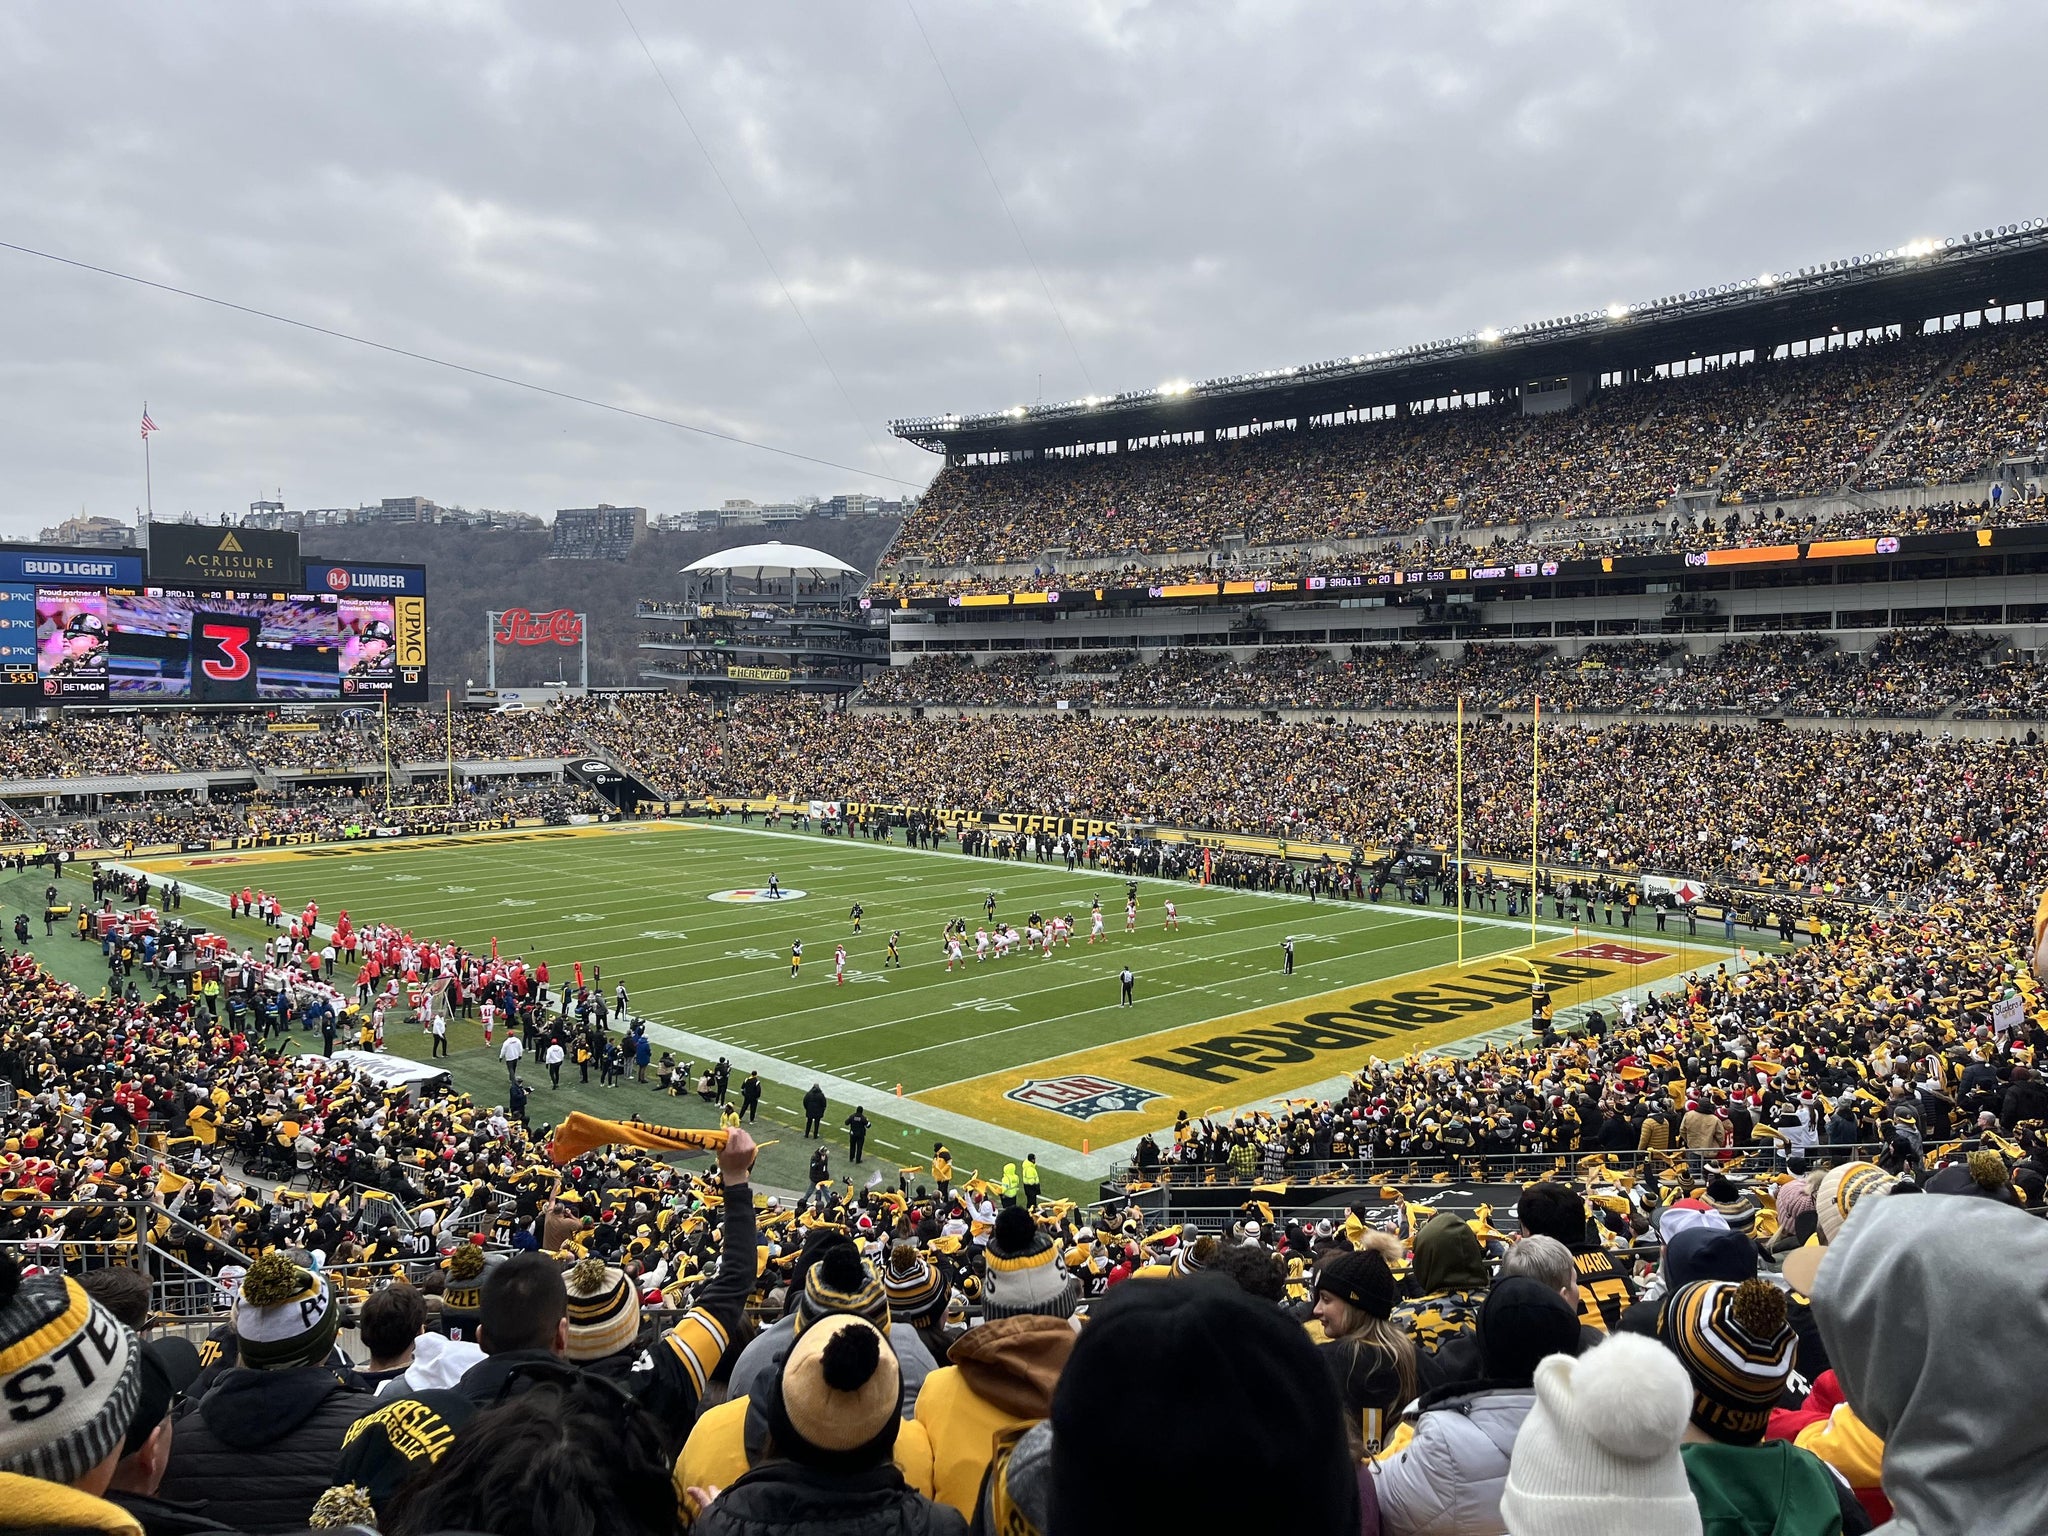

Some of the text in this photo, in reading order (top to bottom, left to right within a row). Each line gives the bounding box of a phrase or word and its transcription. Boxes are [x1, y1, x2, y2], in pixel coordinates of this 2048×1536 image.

[185, 554, 274, 569] ACRISURE
[25, 561, 114, 576] BUD LIGHT
[204, 568, 257, 578] STADIUM
[1472, 568, 1506, 578] CHIEFS
[330, 572, 405, 588] 84 LUMBER
[1378, 575, 1390, 584] 20
[1406, 572, 1444, 582] 1ST 5:59
[1271, 582, 1298, 592] Steelers
[12, 592, 34, 601] PNC
[38, 588, 62, 596] Proud
[63, 590, 91, 598] partner
[12, 620, 34, 628] PNC
[404, 601, 422, 662] UPMC
[12, 647, 34, 656] PNC
[202, 624, 251, 681] 3
[10, 673, 34, 682] 5:59
[730, 668, 787, 680] #HEREWEGO
[359, 682, 392, 690] BETMGM
[1648, 884, 1670, 894] Steelers
[1131, 960, 1616, 1084] PITTSBURGH
[1020, 1078, 1119, 1104] NFL
[1332, 1142, 1346, 1153] 22
[1358, 1144, 1374, 1160] 58
[1186, 1147, 1198, 1160] 56
[496, 1227, 510, 1246] 44
